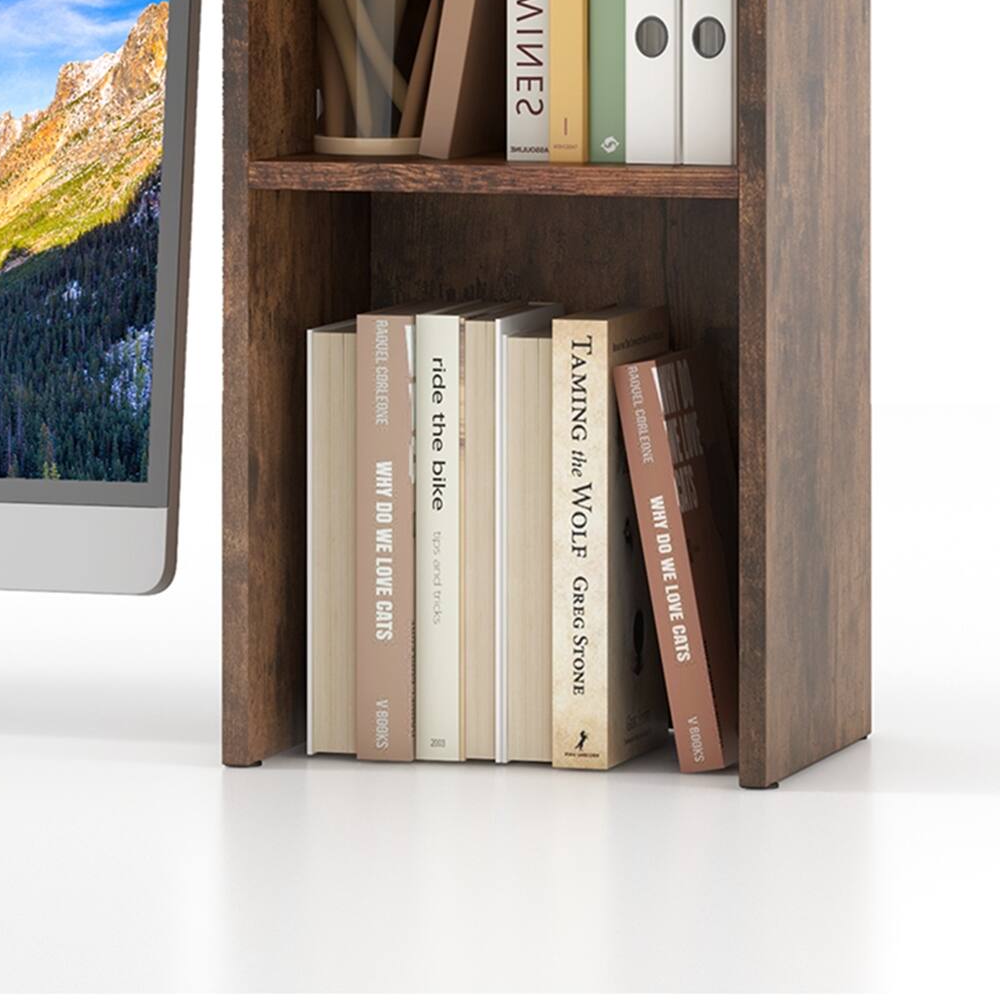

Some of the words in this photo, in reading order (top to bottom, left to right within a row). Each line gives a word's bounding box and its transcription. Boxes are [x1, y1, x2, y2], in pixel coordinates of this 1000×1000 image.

[375, 366, 390, 425] CORLEONE
[432, 357, 446, 404] ride
[571, 335, 592, 441] TAMING
[432, 412, 446, 452] the
[635, 407, 654, 464] CORLEONE
[375, 461, 393, 497] WHY
[571, 450, 585, 478] the
[432, 461, 446, 511] bike
[375, 503, 393, 523] DO
[571, 482, 592, 559] WOLF
[650, 495, 669, 530] WHY
[375, 528, 393, 553] WE
[432, 531, 441, 556] tips
[657, 533, 672, 554] DO
[375, 557, 393, 596] LOVE
[433, 559, 442, 587] and
[661, 557, 677, 582] WE
[375, 601, 393, 641] CATS
[432, 590, 441, 625] tricks
[572, 576, 589, 629] GREG
[665, 584, 684, 621] LOVE
[672, 624, 691, 662] CATS
[572, 635, 589, 696] STONE
[376, 699, 388, 707] V
[375, 710, 389, 749] BOOKS
[689, 726, 704, 763] BOOKS
